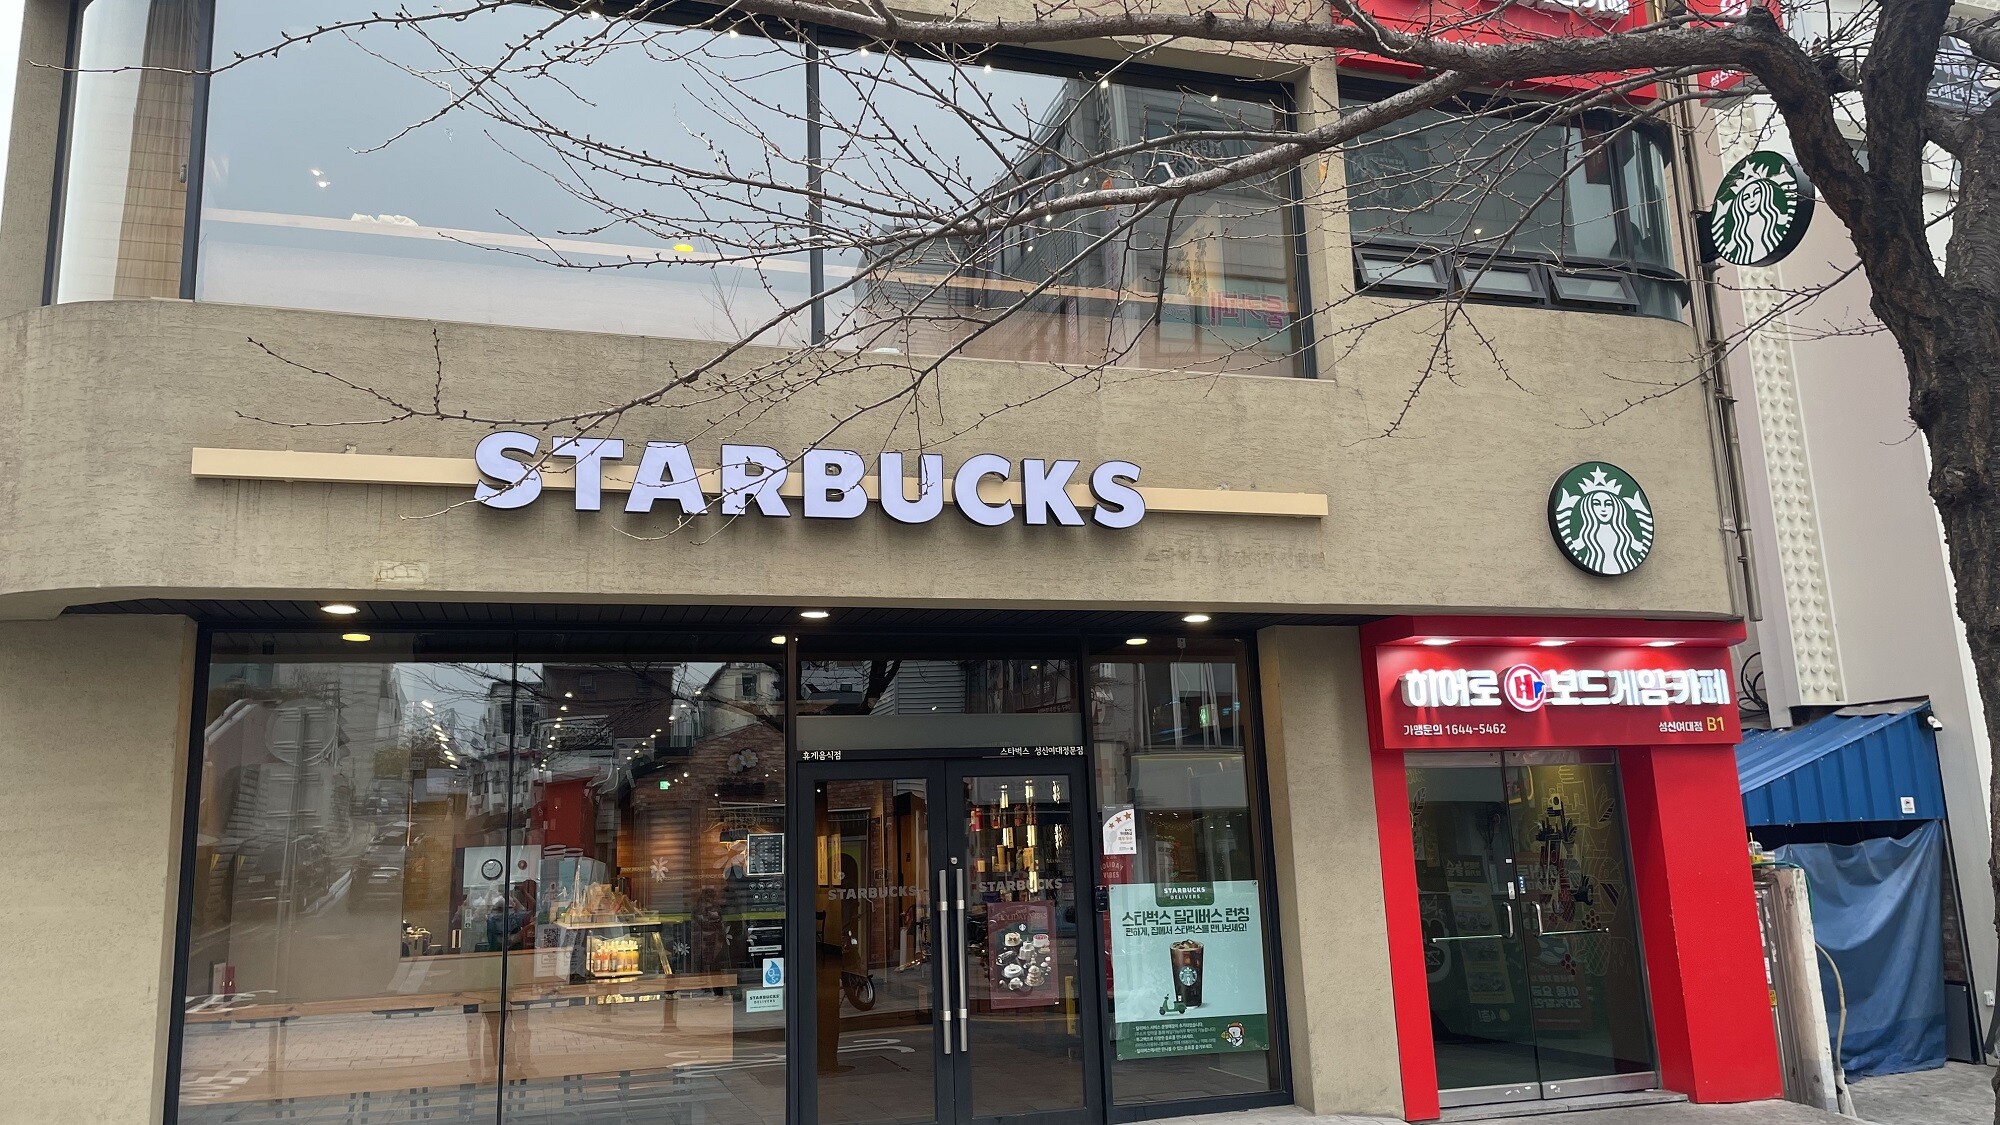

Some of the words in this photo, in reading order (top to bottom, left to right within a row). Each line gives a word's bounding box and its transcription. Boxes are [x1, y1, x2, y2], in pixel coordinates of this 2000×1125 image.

[474, 430, 1146, 529] STARBUCKS
[1404, 668, 1502, 707] 히어로
[1548, 668, 1731, 706] 보드게임카페
[1403, 724, 1443, 736] 가맹문의
[1445, 724, 1507, 735] 1644-5462
[1658, 721, 1704, 733] 성신여대점
[1707, 717, 1725, 732] B1
[802, 750, 842, 761] 휴게음식점
[1000, 747, 1030, 756] 스타벅스
[1101, 863, 1124, 871] OLIDAY
[828, 885, 917, 900] STARBUCKS
[1163, 886, 1206, 894] STARBUCKS
[1122, 910, 1172, 927] 스타벅스
[1174, 909, 1222, 924] 딜리버스
[1225, 907, 1250, 922] 런칭
[1125, 926, 1150, 937] 편하게,
[1151, 926, 1173, 936] 집에서
[1174, 925, 1210, 935] 스타벅스를
[1210, 923, 1248, 933] 만나보세요!
